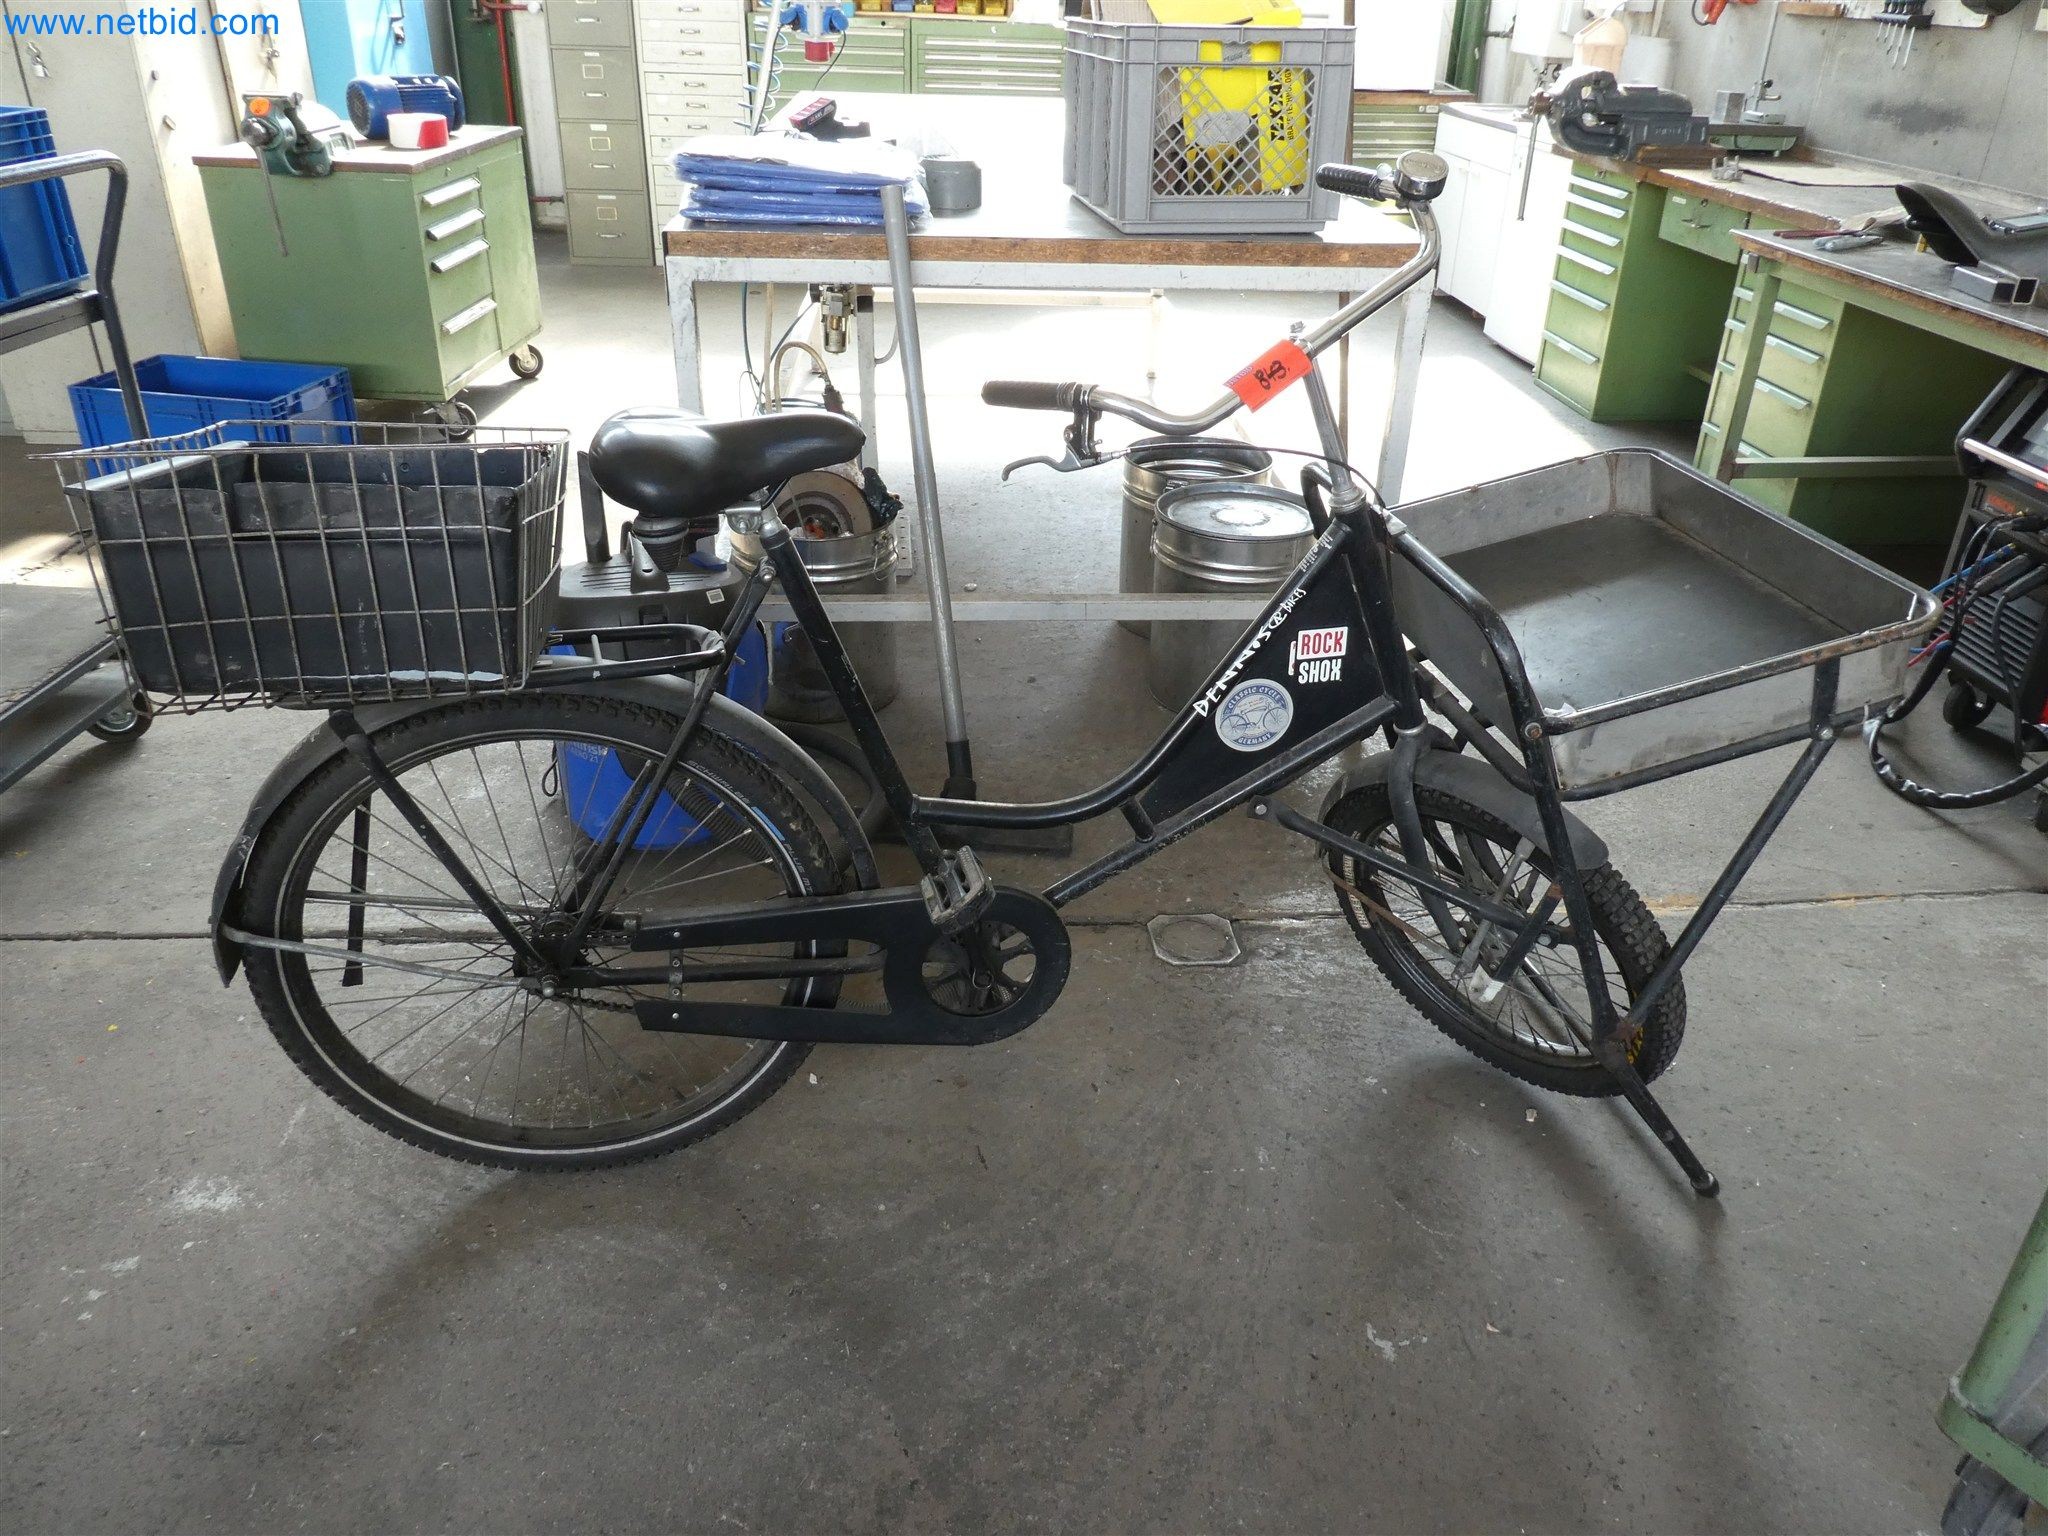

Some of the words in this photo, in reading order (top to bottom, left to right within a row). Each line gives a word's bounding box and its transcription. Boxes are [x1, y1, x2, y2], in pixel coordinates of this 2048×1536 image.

[1301, 630, 1344, 656] ROCK
[1298, 658, 1342, 685] SHOX
[1228, 686, 1257, 709] CLASSIC
[1259, 686, 1280, 702] CYCLE
[1238, 732, 1273, 745] GERMANY
